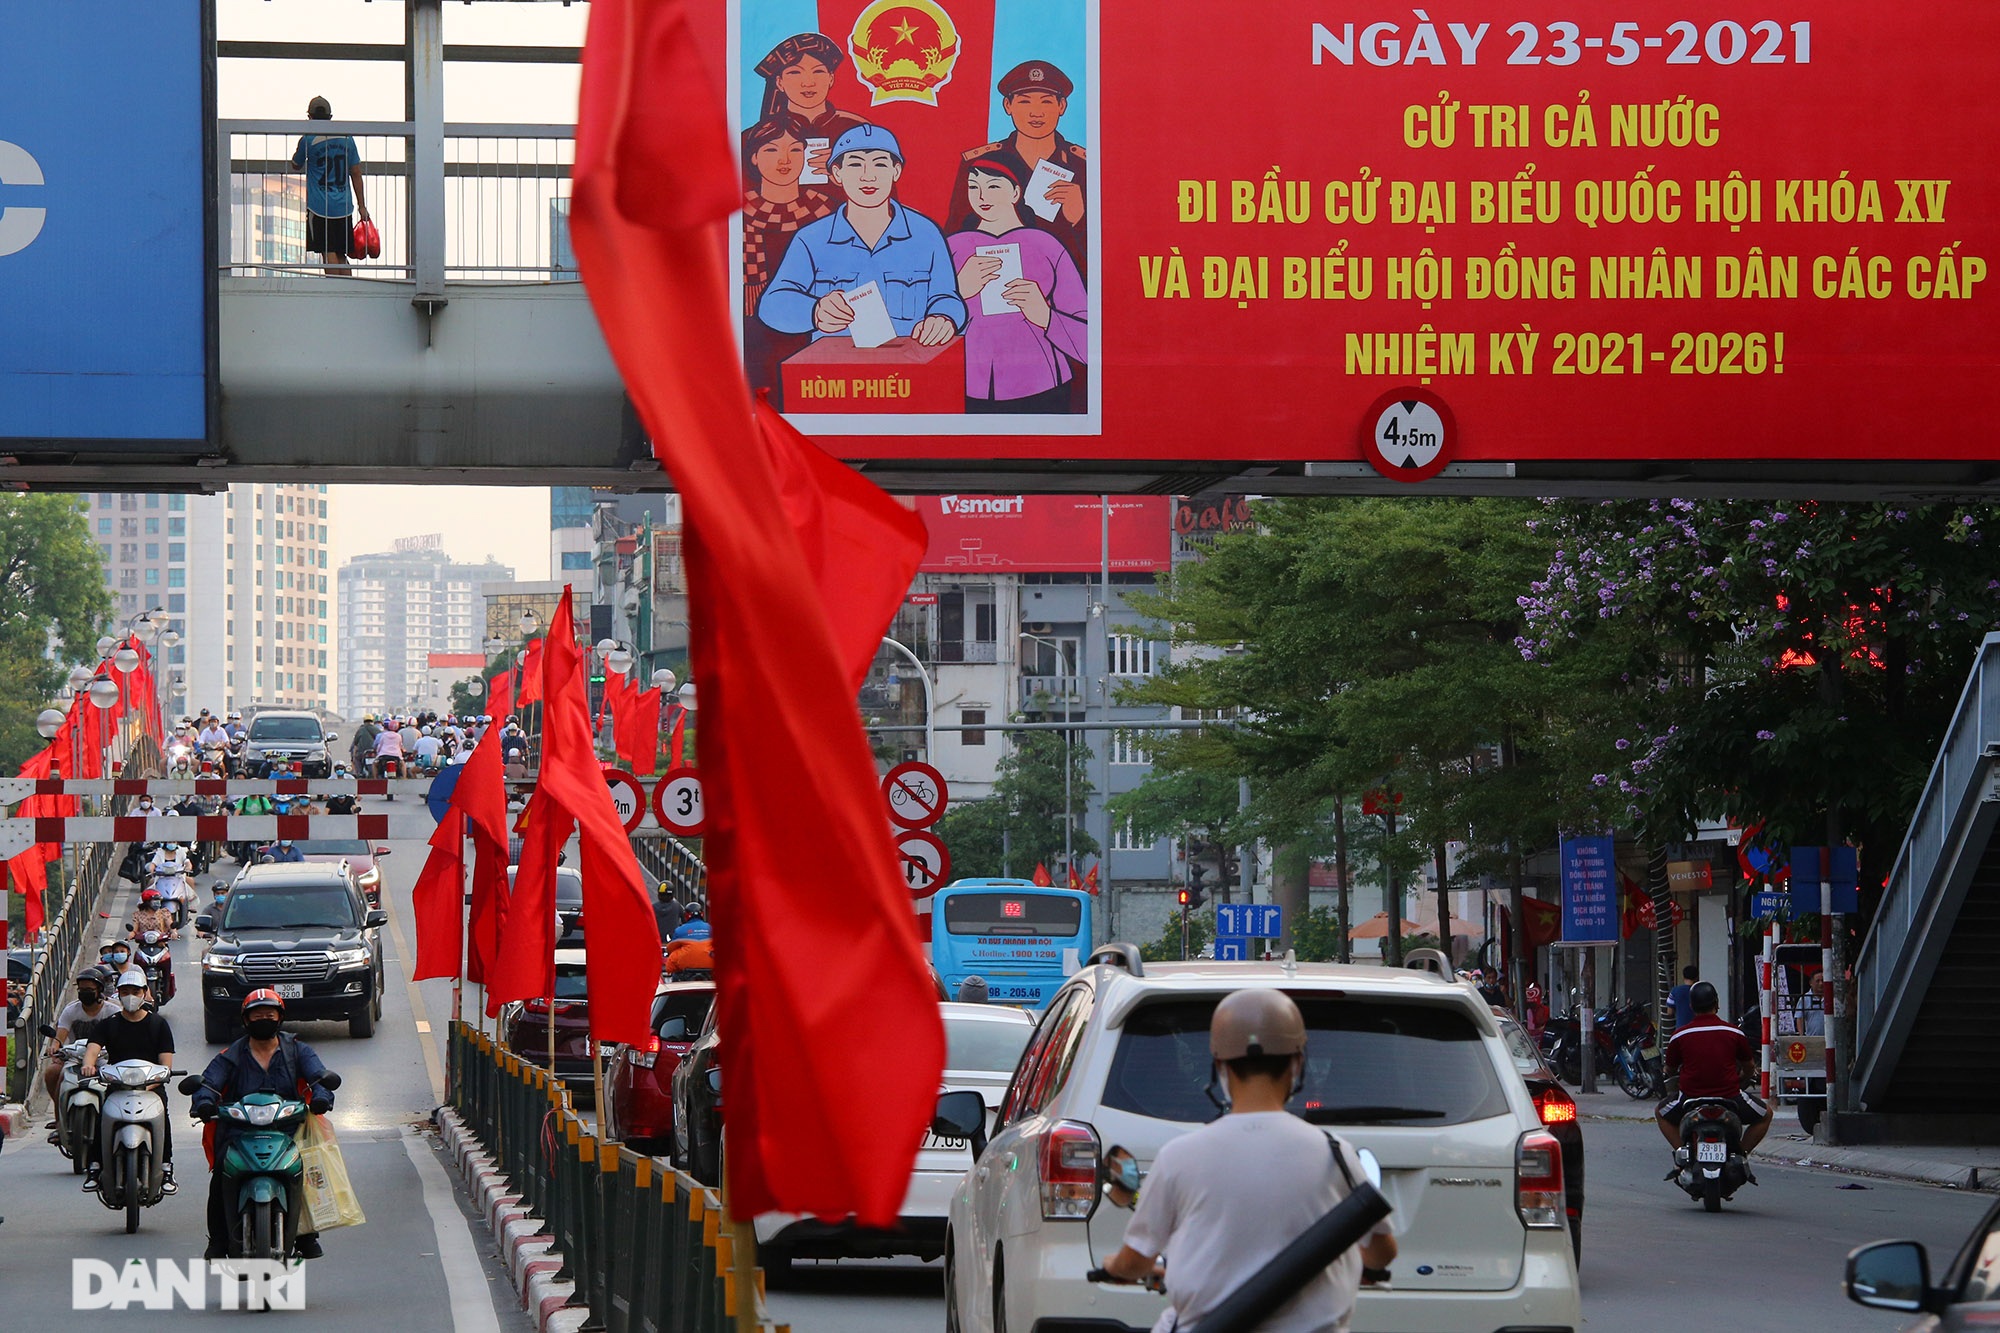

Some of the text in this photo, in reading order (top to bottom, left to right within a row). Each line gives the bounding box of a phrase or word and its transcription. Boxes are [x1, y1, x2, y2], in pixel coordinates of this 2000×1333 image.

[1312, 9, 1811, 66] NGÀY 23-5-2021
[1403, 90, 1720, 148] CỬ TRI CẢ NƯỚC
[1177, 163, 1951, 233] ĐI BẦU CỬ ĐẠI BIỂU QUỐC HỘI KHÓA XV
[1138, 239, 1987, 309] VÀ ĐẠI BIỂU HỘI ĐỒNG NHÂN DÂN CÁC CẤP
[1345, 323, 1475, 385] NHIỆM
[1489, 323, 1540, 375] KỲ
[800, 372, 911, 399] HÒM PHIẾU
[1383, 416, 1437, 447] 4,5m
[1670, 870, 1709, 881] VENESTO
[1004, 902, 1021, 916] 02
[1011, 950, 1033, 958] 1900
[1009, 987, 1041, 998] 205.46
[1699, 1151, 1725, 1161] 711.82
